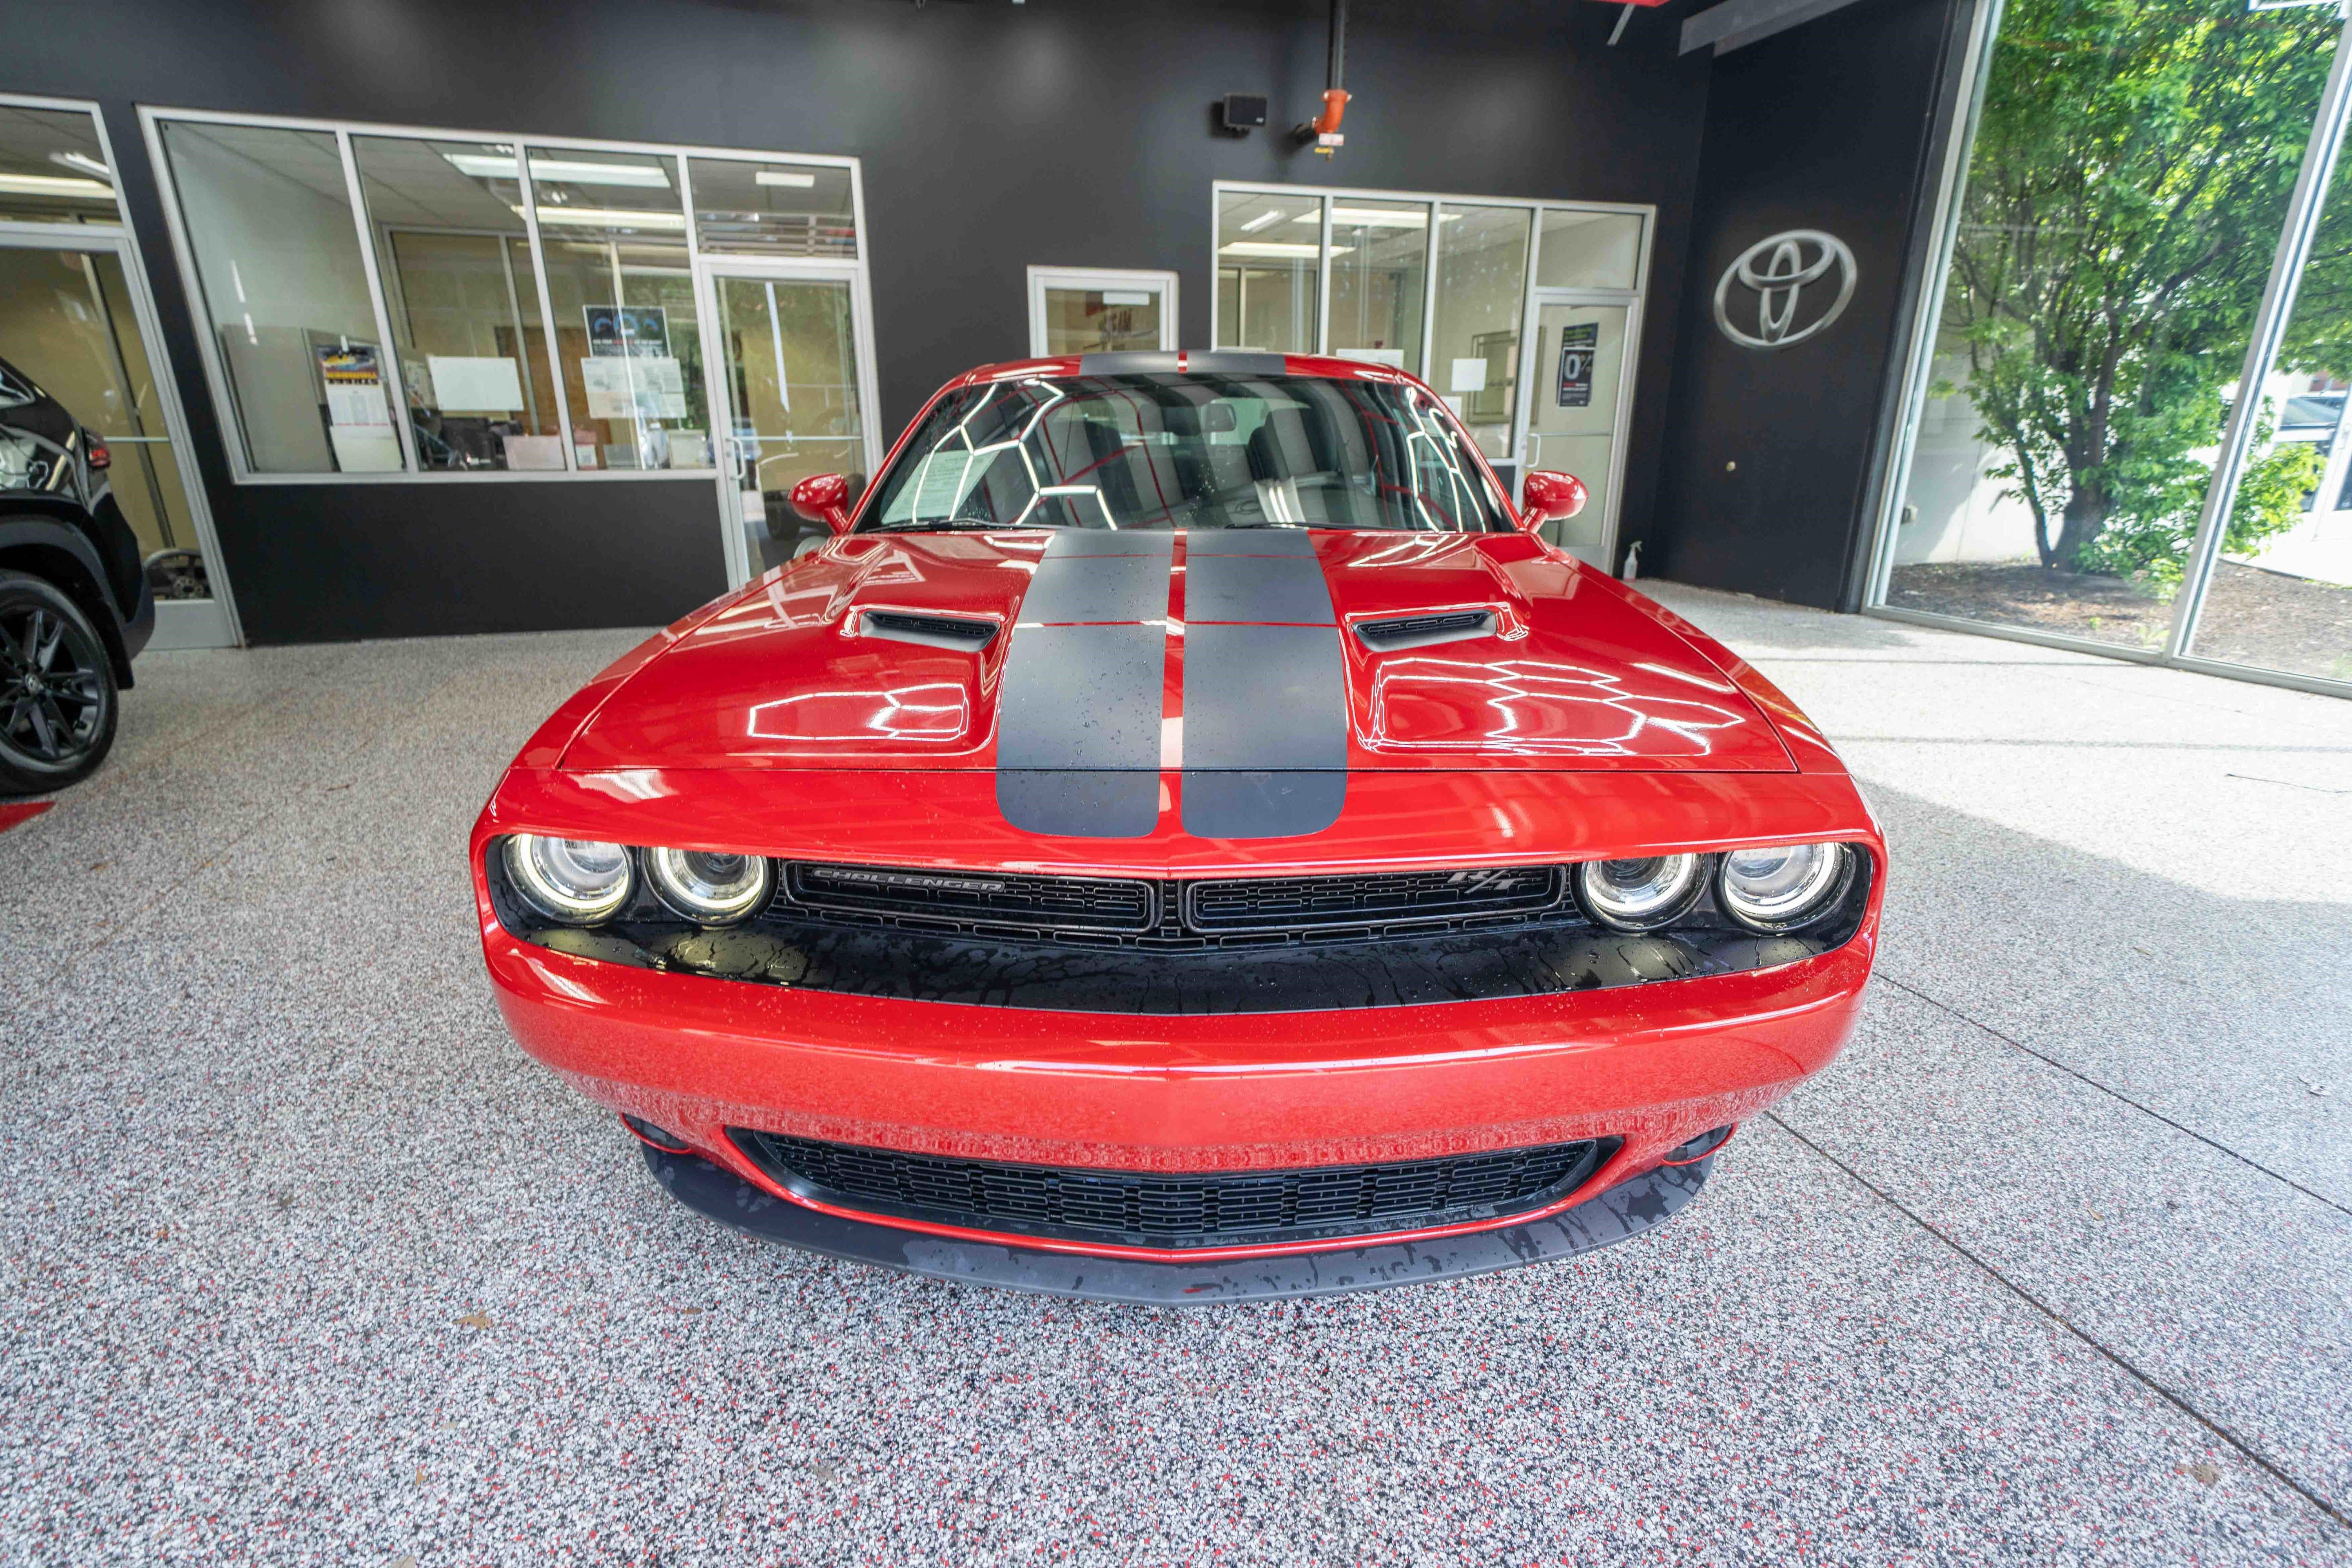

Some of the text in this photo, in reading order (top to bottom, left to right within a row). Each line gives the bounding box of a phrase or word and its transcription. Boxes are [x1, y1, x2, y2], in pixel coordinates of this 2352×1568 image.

[1564, 354, 1592, 380] 0%
[813, 869, 1003, 891] CHALLENGER
[1447, 870, 1526, 894] R/T
